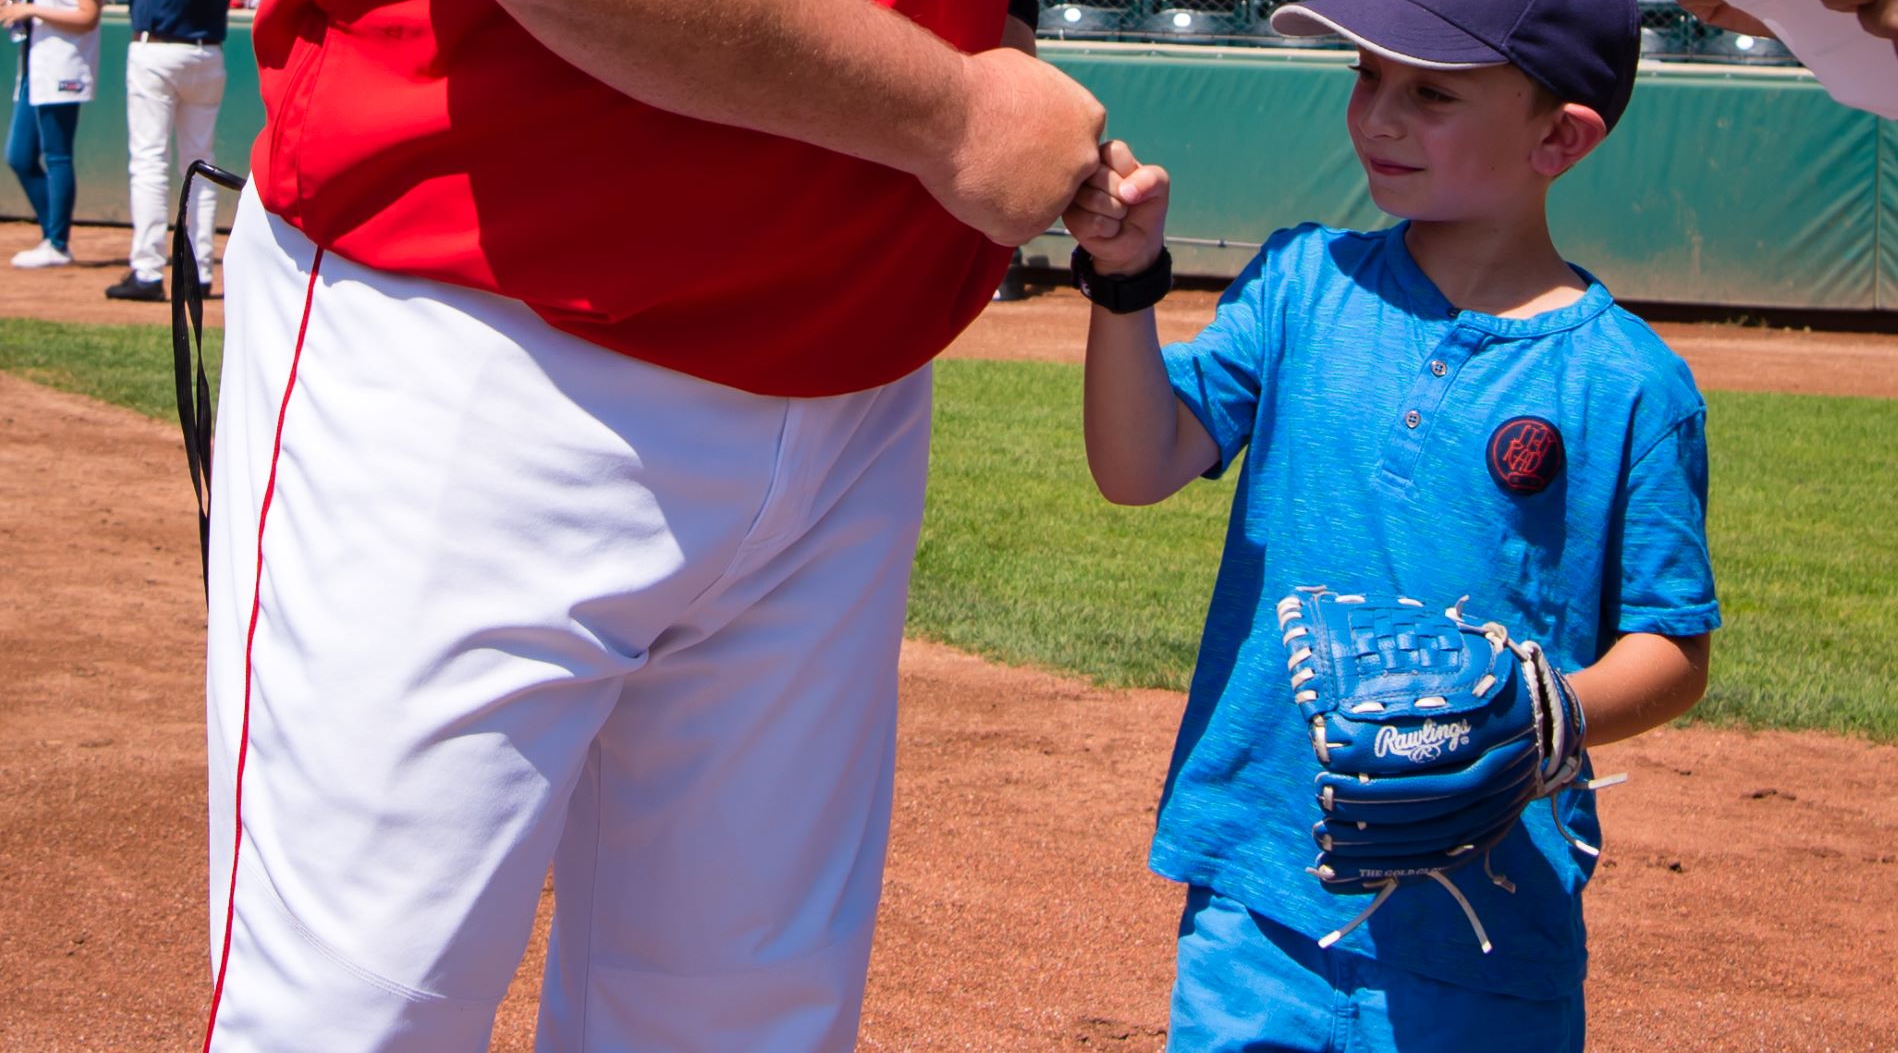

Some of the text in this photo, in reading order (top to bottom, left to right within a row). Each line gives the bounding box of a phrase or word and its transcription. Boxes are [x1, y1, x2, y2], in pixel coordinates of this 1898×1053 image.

[1374, 718, 1471, 758] Rawlings
[1359, 868, 1383, 878] THE
[1384, 868, 1415, 877] GOLD
